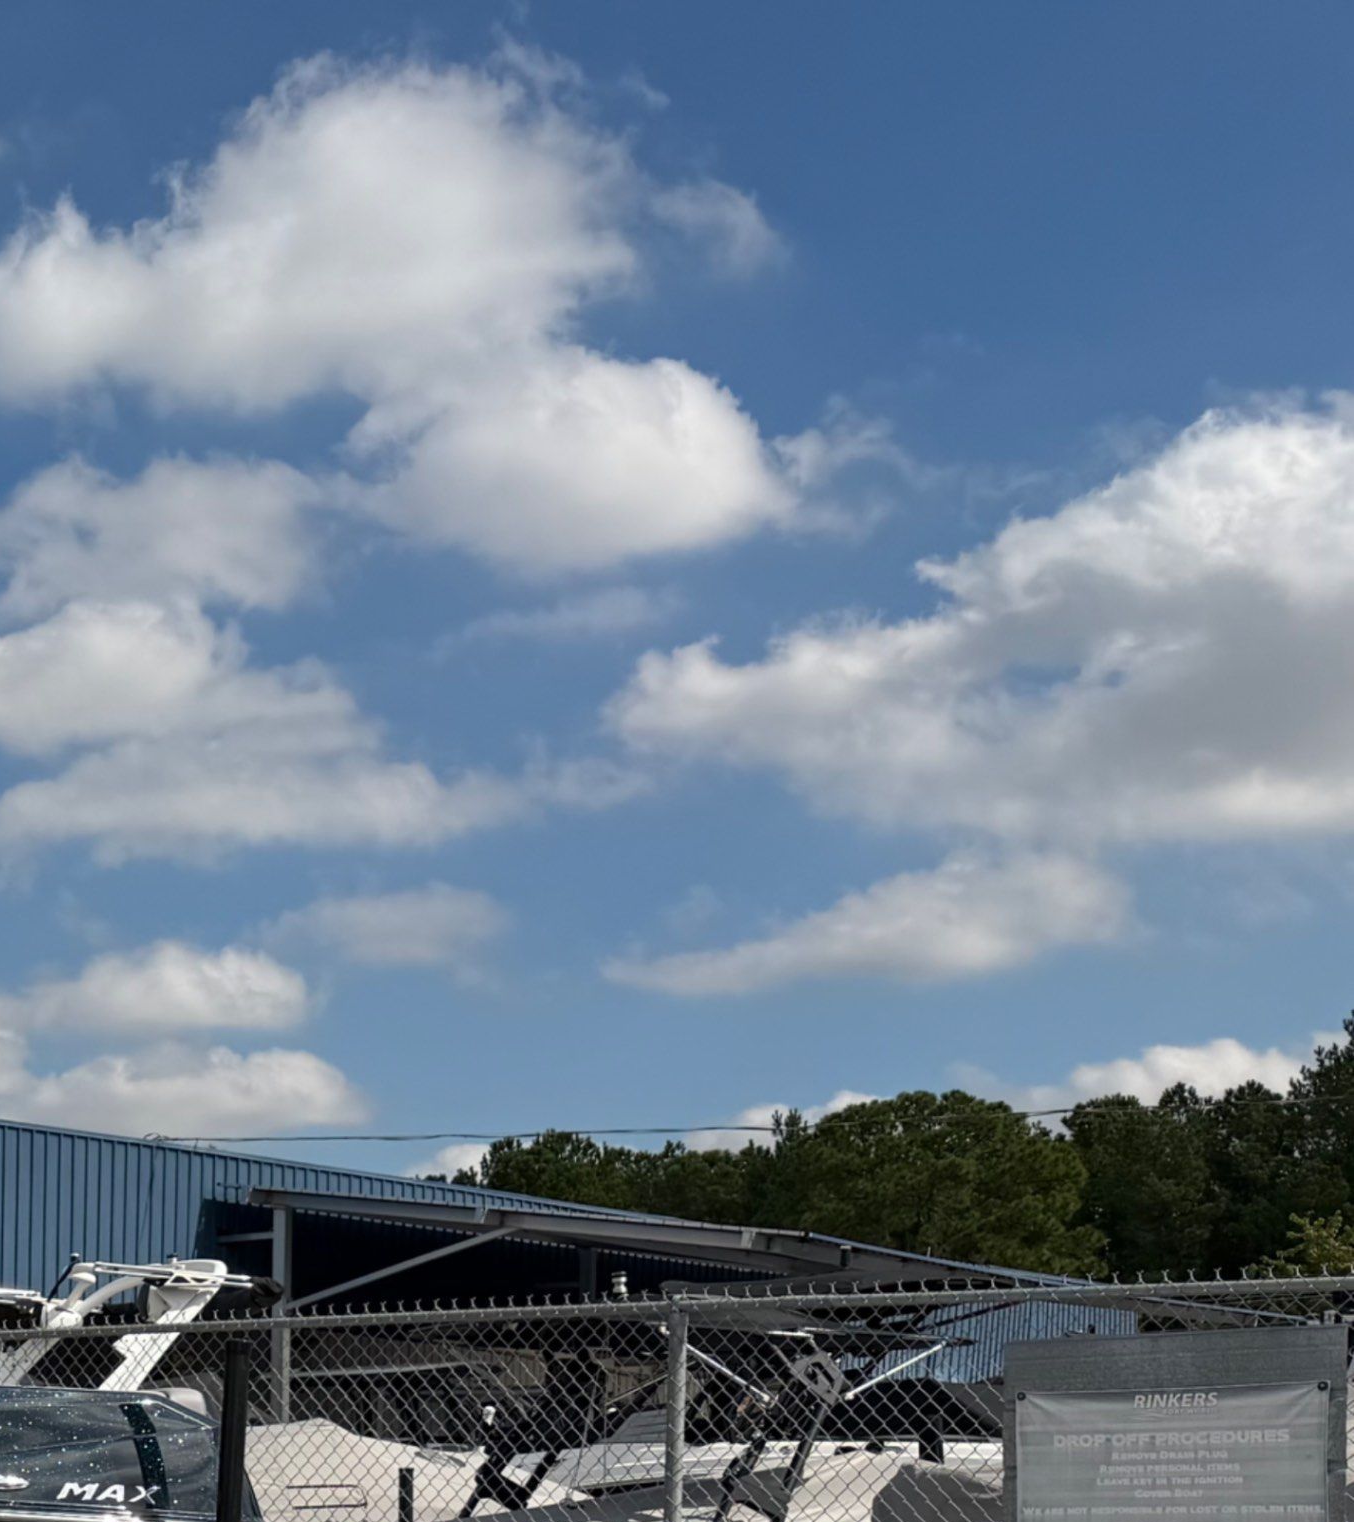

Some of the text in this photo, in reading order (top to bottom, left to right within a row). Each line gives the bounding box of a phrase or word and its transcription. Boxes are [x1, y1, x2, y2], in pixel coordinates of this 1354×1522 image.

[1133, 1392, 1218, 1409] RINKERS
[1155, 1429, 1290, 1446] PROCEDURES
[1197, 1450, 1228, 1458] PLUG
[56, 1481, 162, 1504] MAX
[1190, 1506, 1218, 1514] LOST
